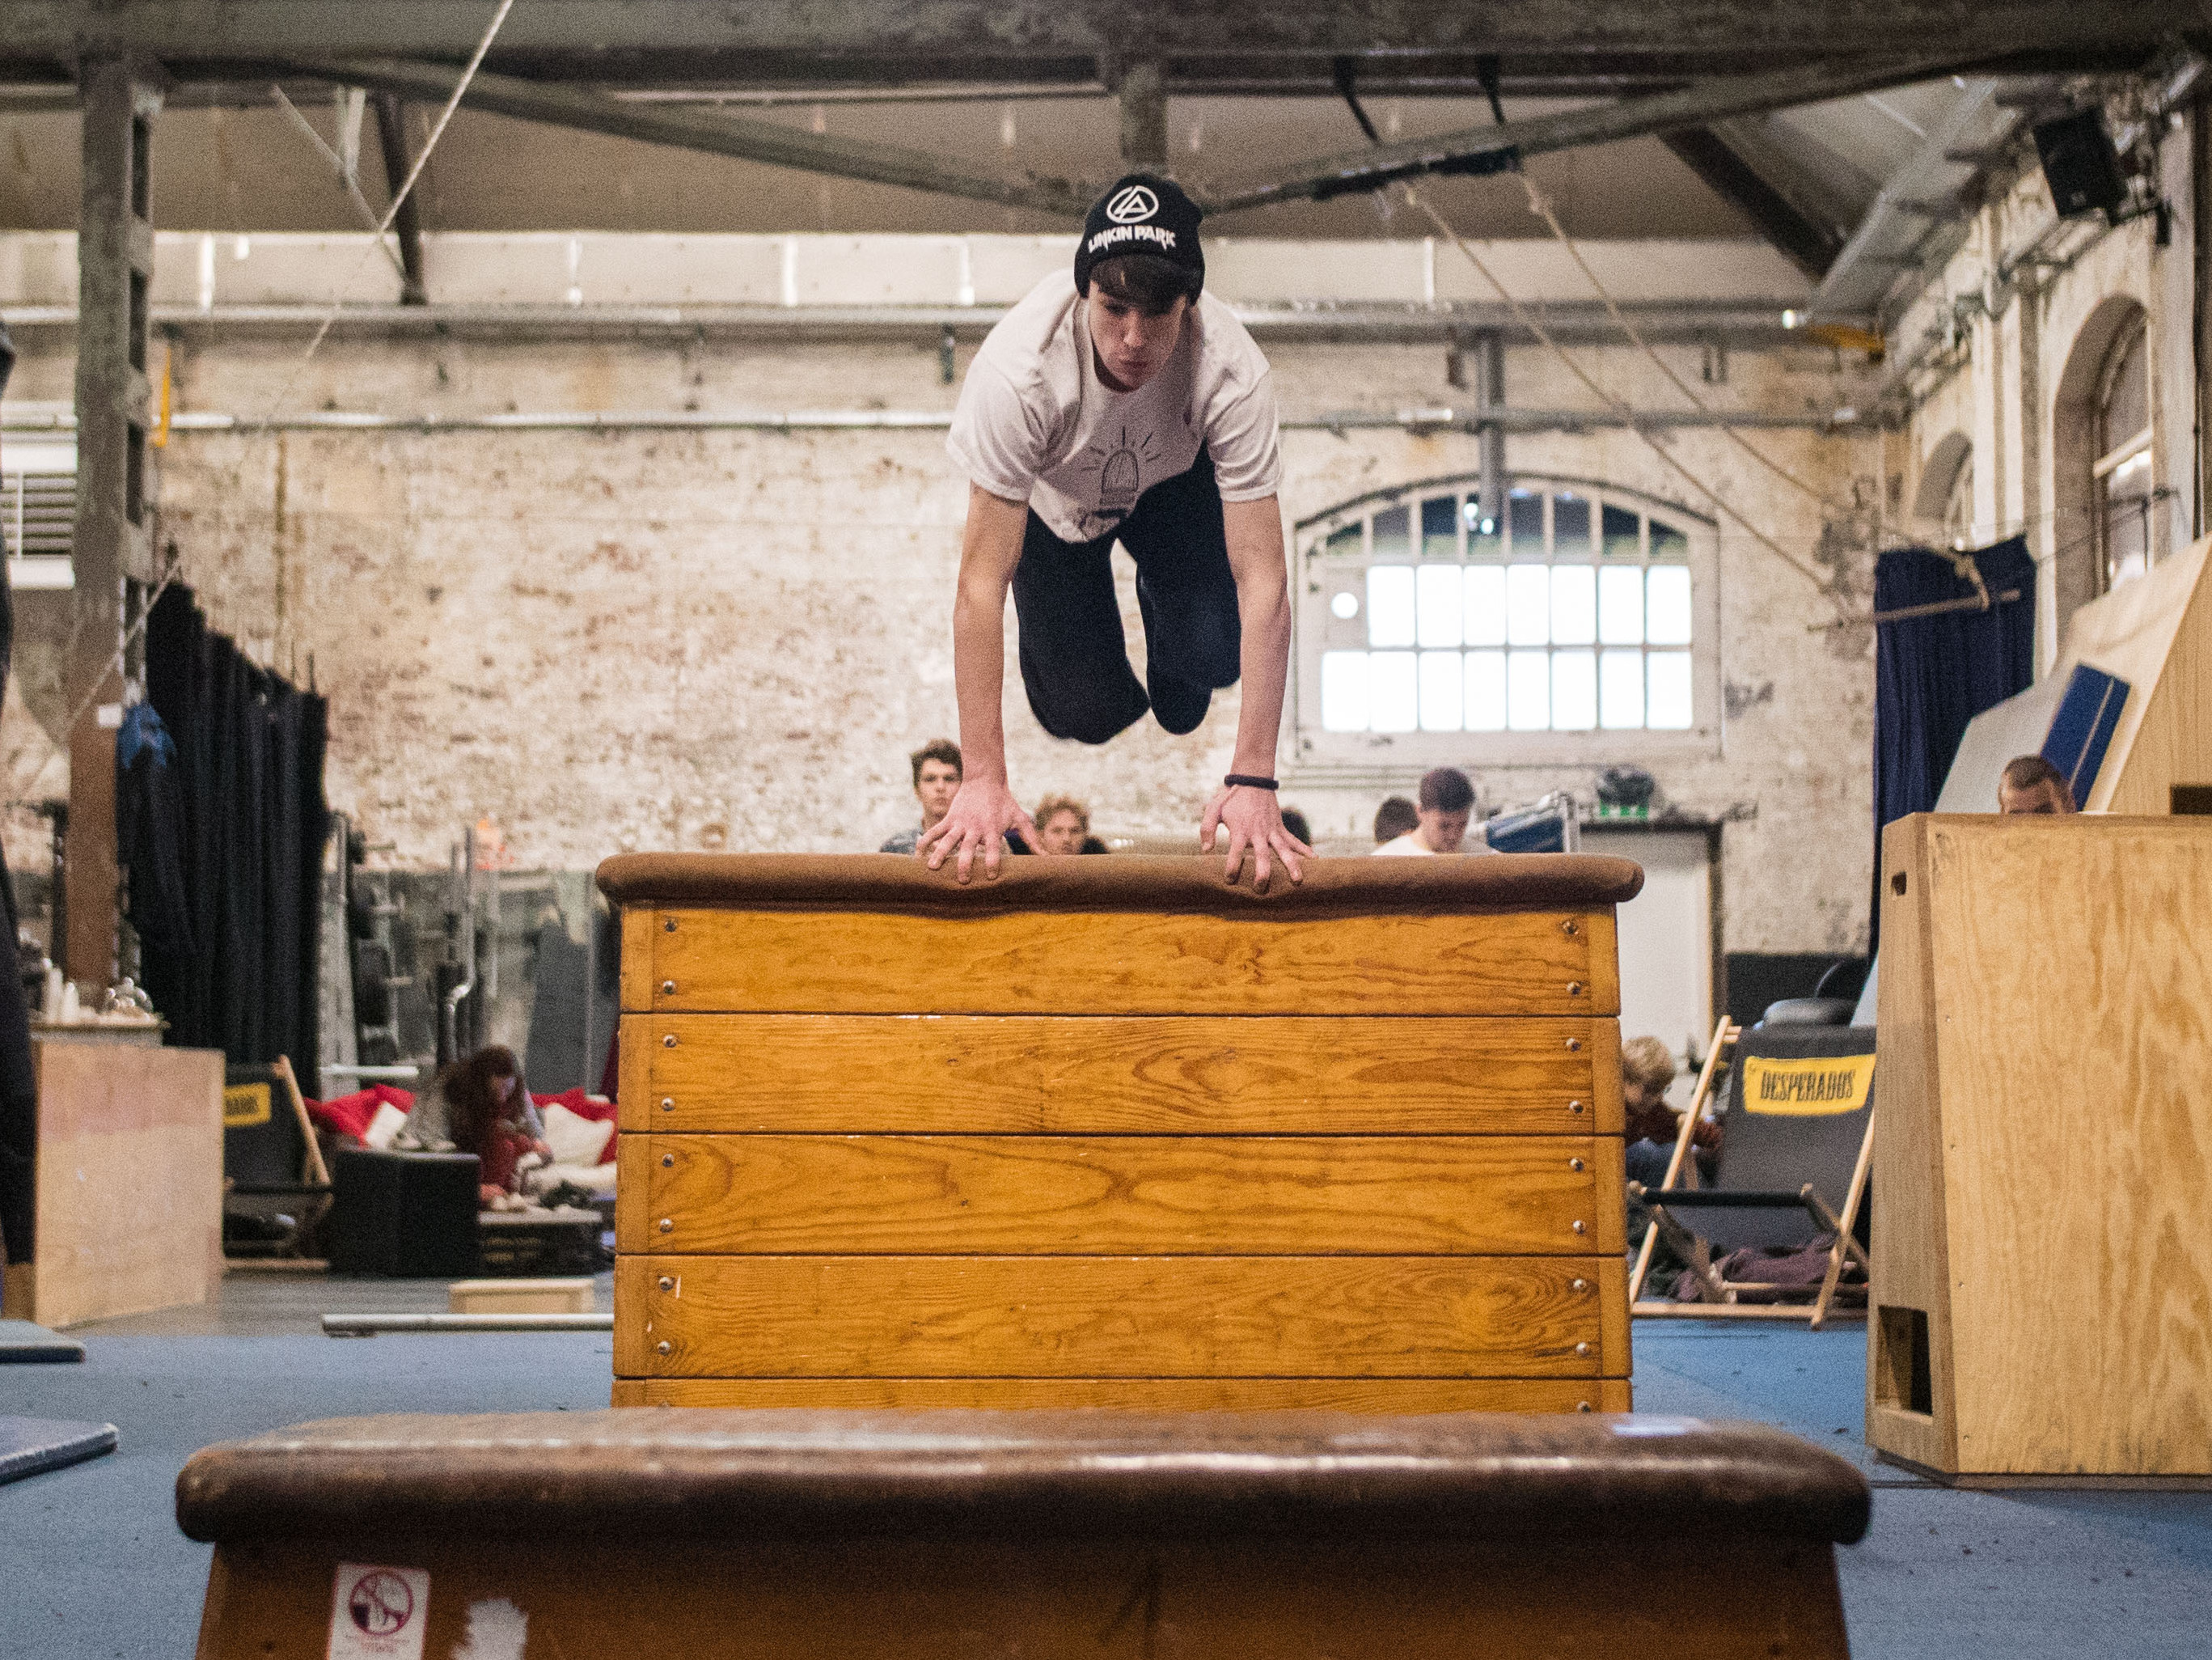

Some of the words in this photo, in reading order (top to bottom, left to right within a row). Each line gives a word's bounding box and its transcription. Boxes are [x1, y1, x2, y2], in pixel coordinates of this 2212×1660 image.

[1088, 225, 1132, 253] LINKIN
[1134, 225, 1177, 251] PARK
[1761, 1070, 1855, 1101] DESPERADOS
